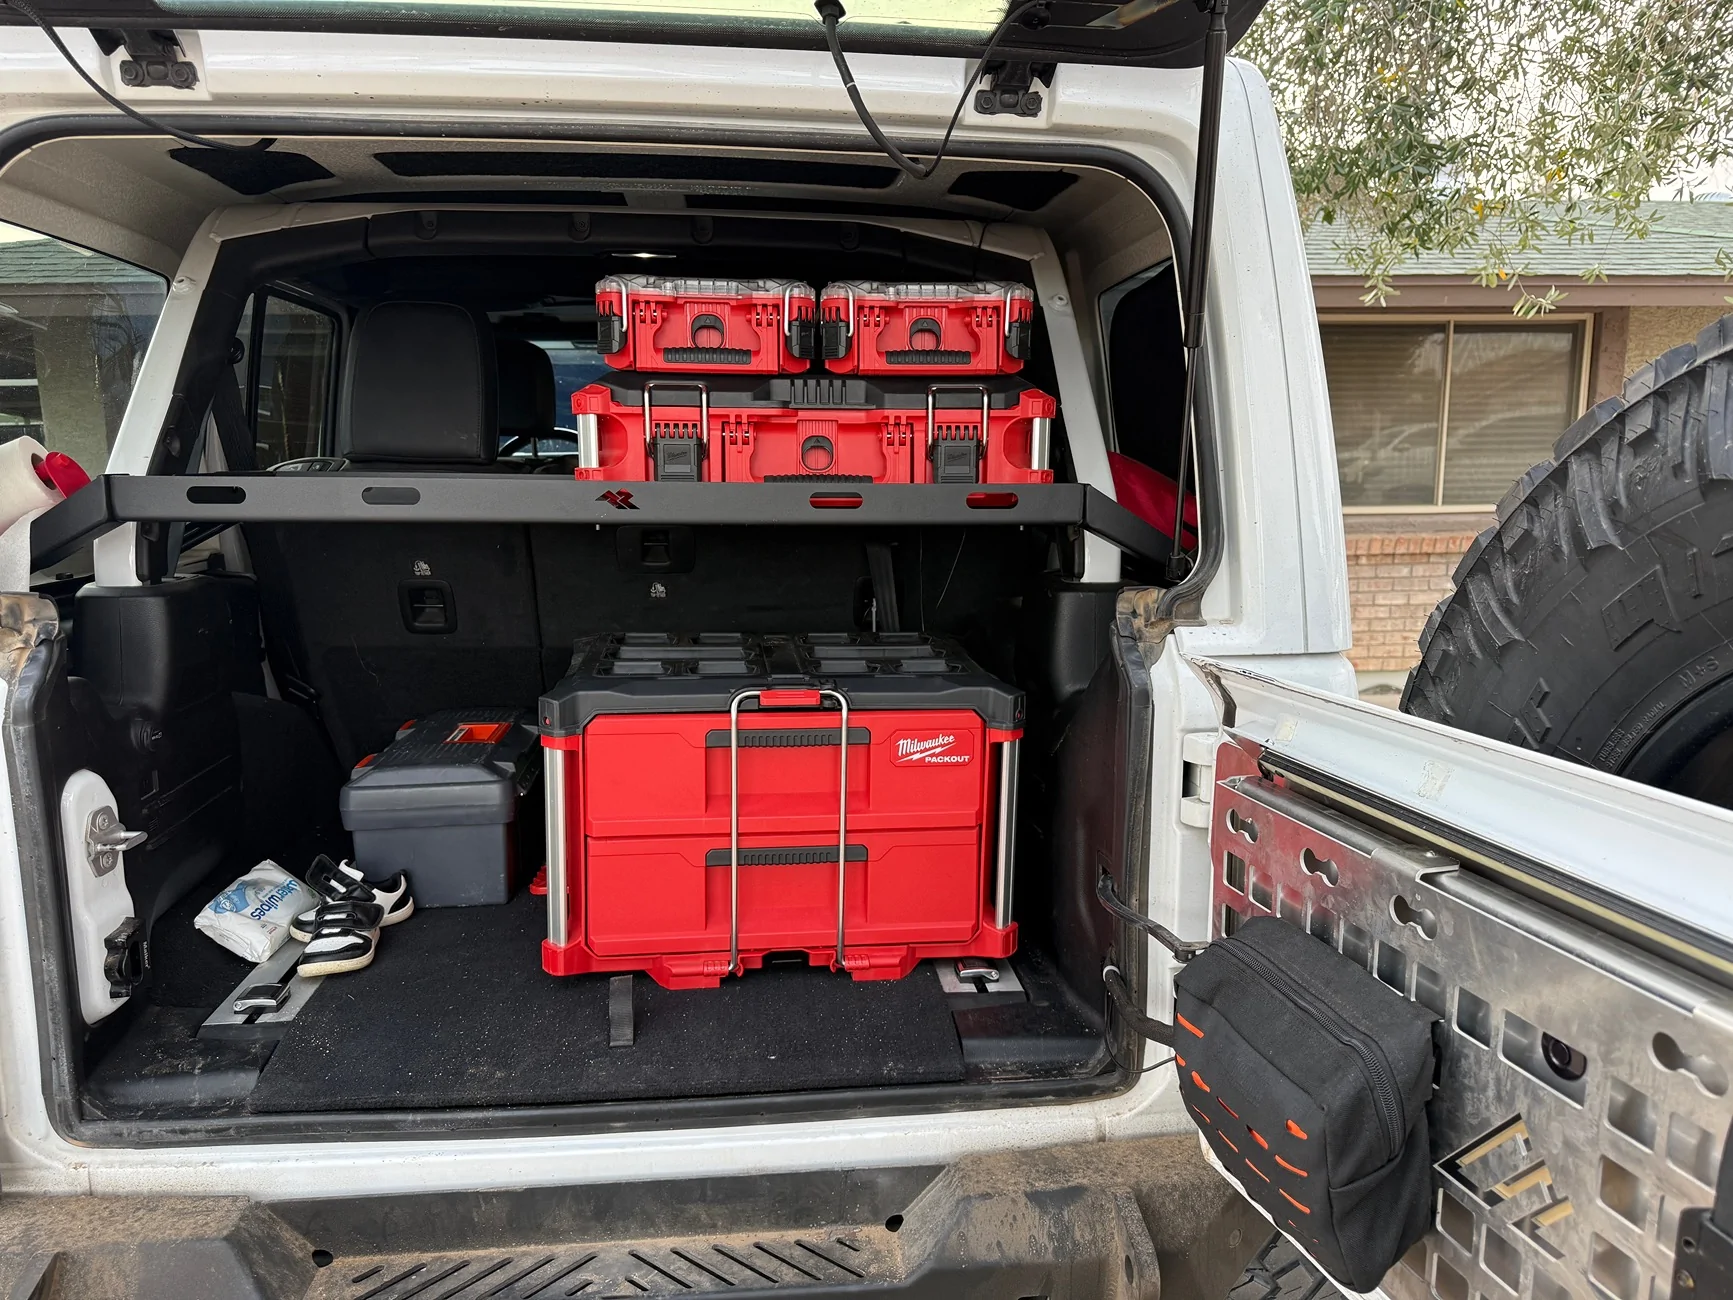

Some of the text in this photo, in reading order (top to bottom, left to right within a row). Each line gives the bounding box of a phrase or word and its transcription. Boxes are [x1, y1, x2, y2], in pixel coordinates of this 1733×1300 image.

[1679, 655, 1720, 689] M+S
[1642, 700, 1667, 724] RADIAL
[895, 733, 956, 757] Milwaukee
[1599, 729, 1625, 762] TUBELESS
[924, 755, 970, 763] PACKOUT
